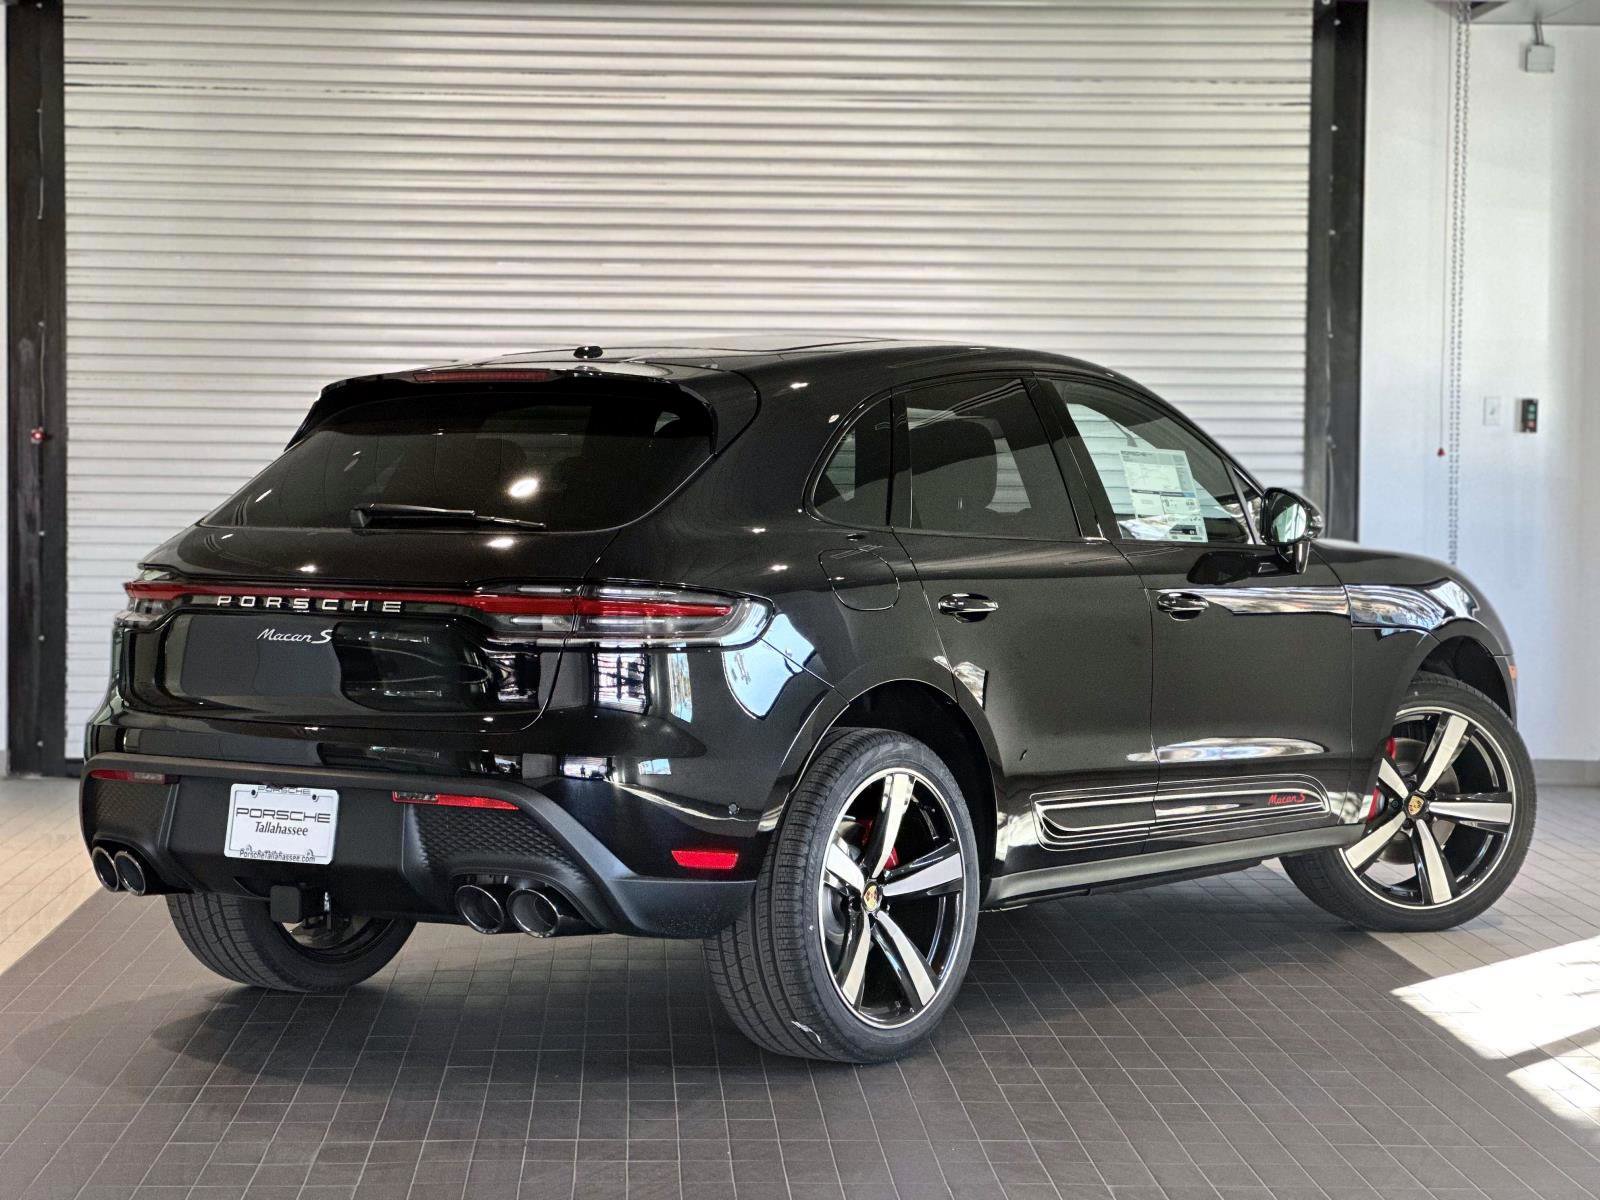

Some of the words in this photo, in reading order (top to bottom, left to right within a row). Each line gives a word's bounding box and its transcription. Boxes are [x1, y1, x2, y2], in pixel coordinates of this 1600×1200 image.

[216, 595, 402, 613] PORSCHE
[257, 628, 313, 643] Macan
[311, 629, 333, 644] S
[1268, 793, 1298, 806] Macan
[236, 807, 331, 824] PORSCHE
[255, 821, 309, 836] Tallahassee
